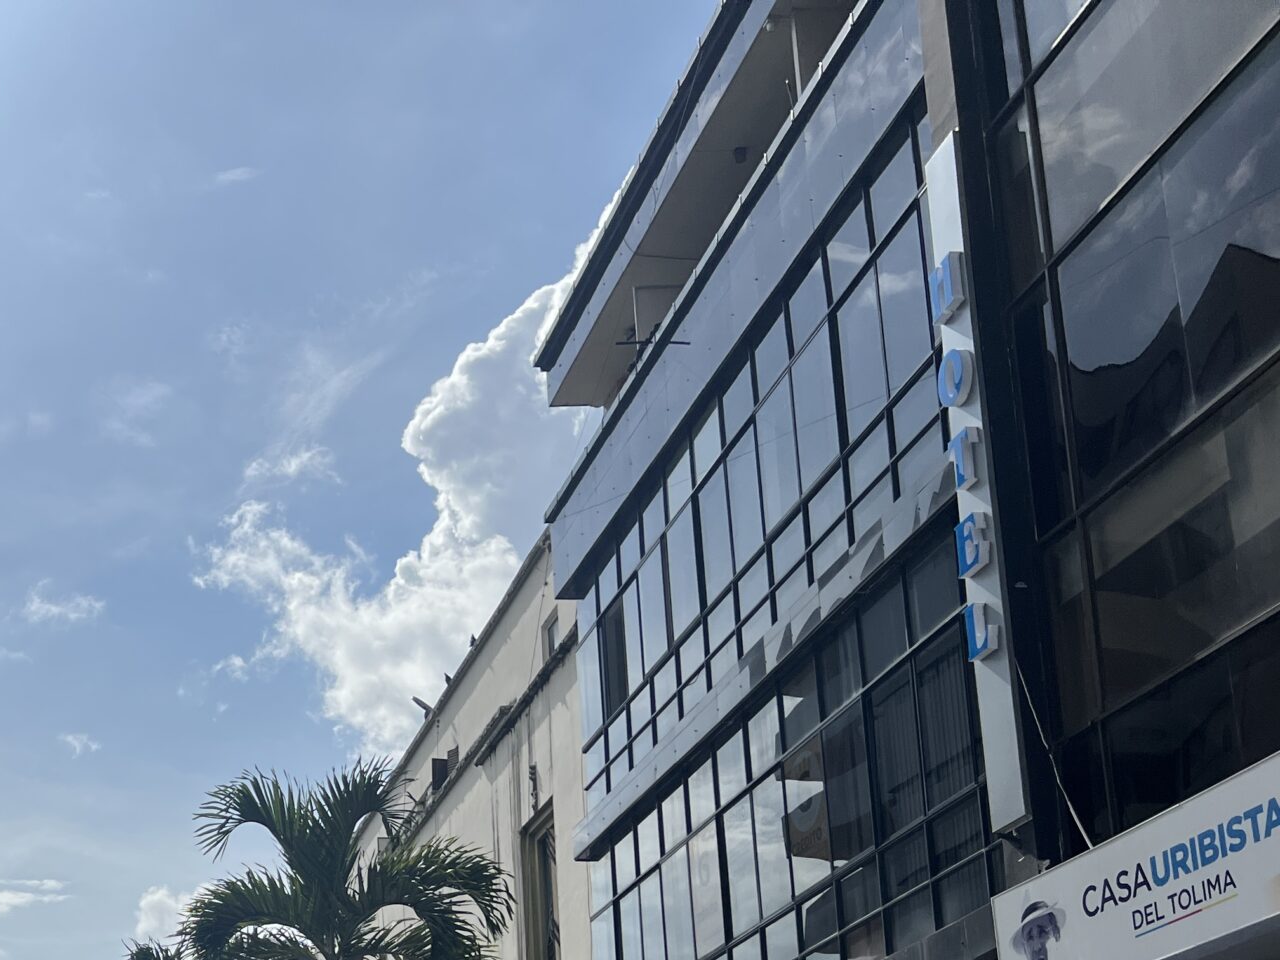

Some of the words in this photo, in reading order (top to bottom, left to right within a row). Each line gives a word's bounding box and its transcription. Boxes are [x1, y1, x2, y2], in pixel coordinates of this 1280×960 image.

[928, 249, 999, 663] HOTEL
[1132, 901, 1165, 930] DEL
[1167, 869, 1237, 914] TOLIMA
